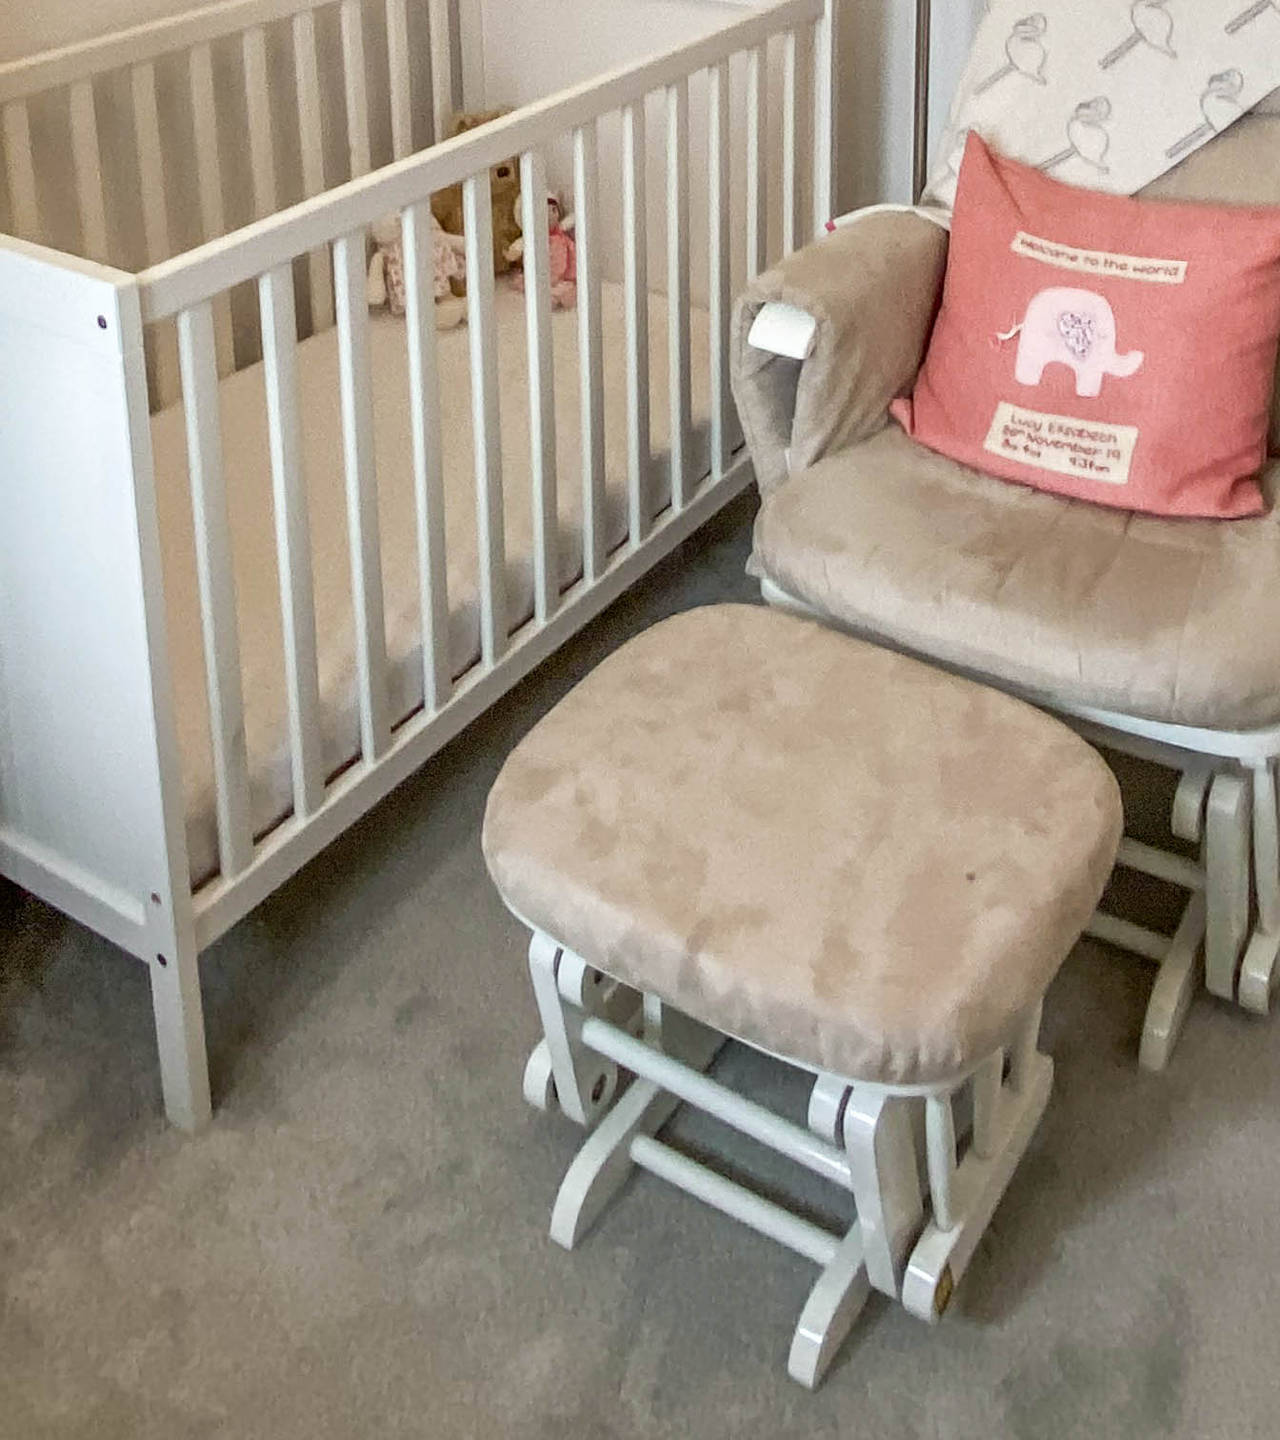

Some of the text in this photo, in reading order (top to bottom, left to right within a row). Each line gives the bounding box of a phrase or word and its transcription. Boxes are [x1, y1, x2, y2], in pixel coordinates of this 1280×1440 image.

[1084, 255, 1099, 266] to
[1104, 258, 1128, 271] the
[1132, 264, 1180, 276] world
[1011, 414, 1043, 432] Lucy
